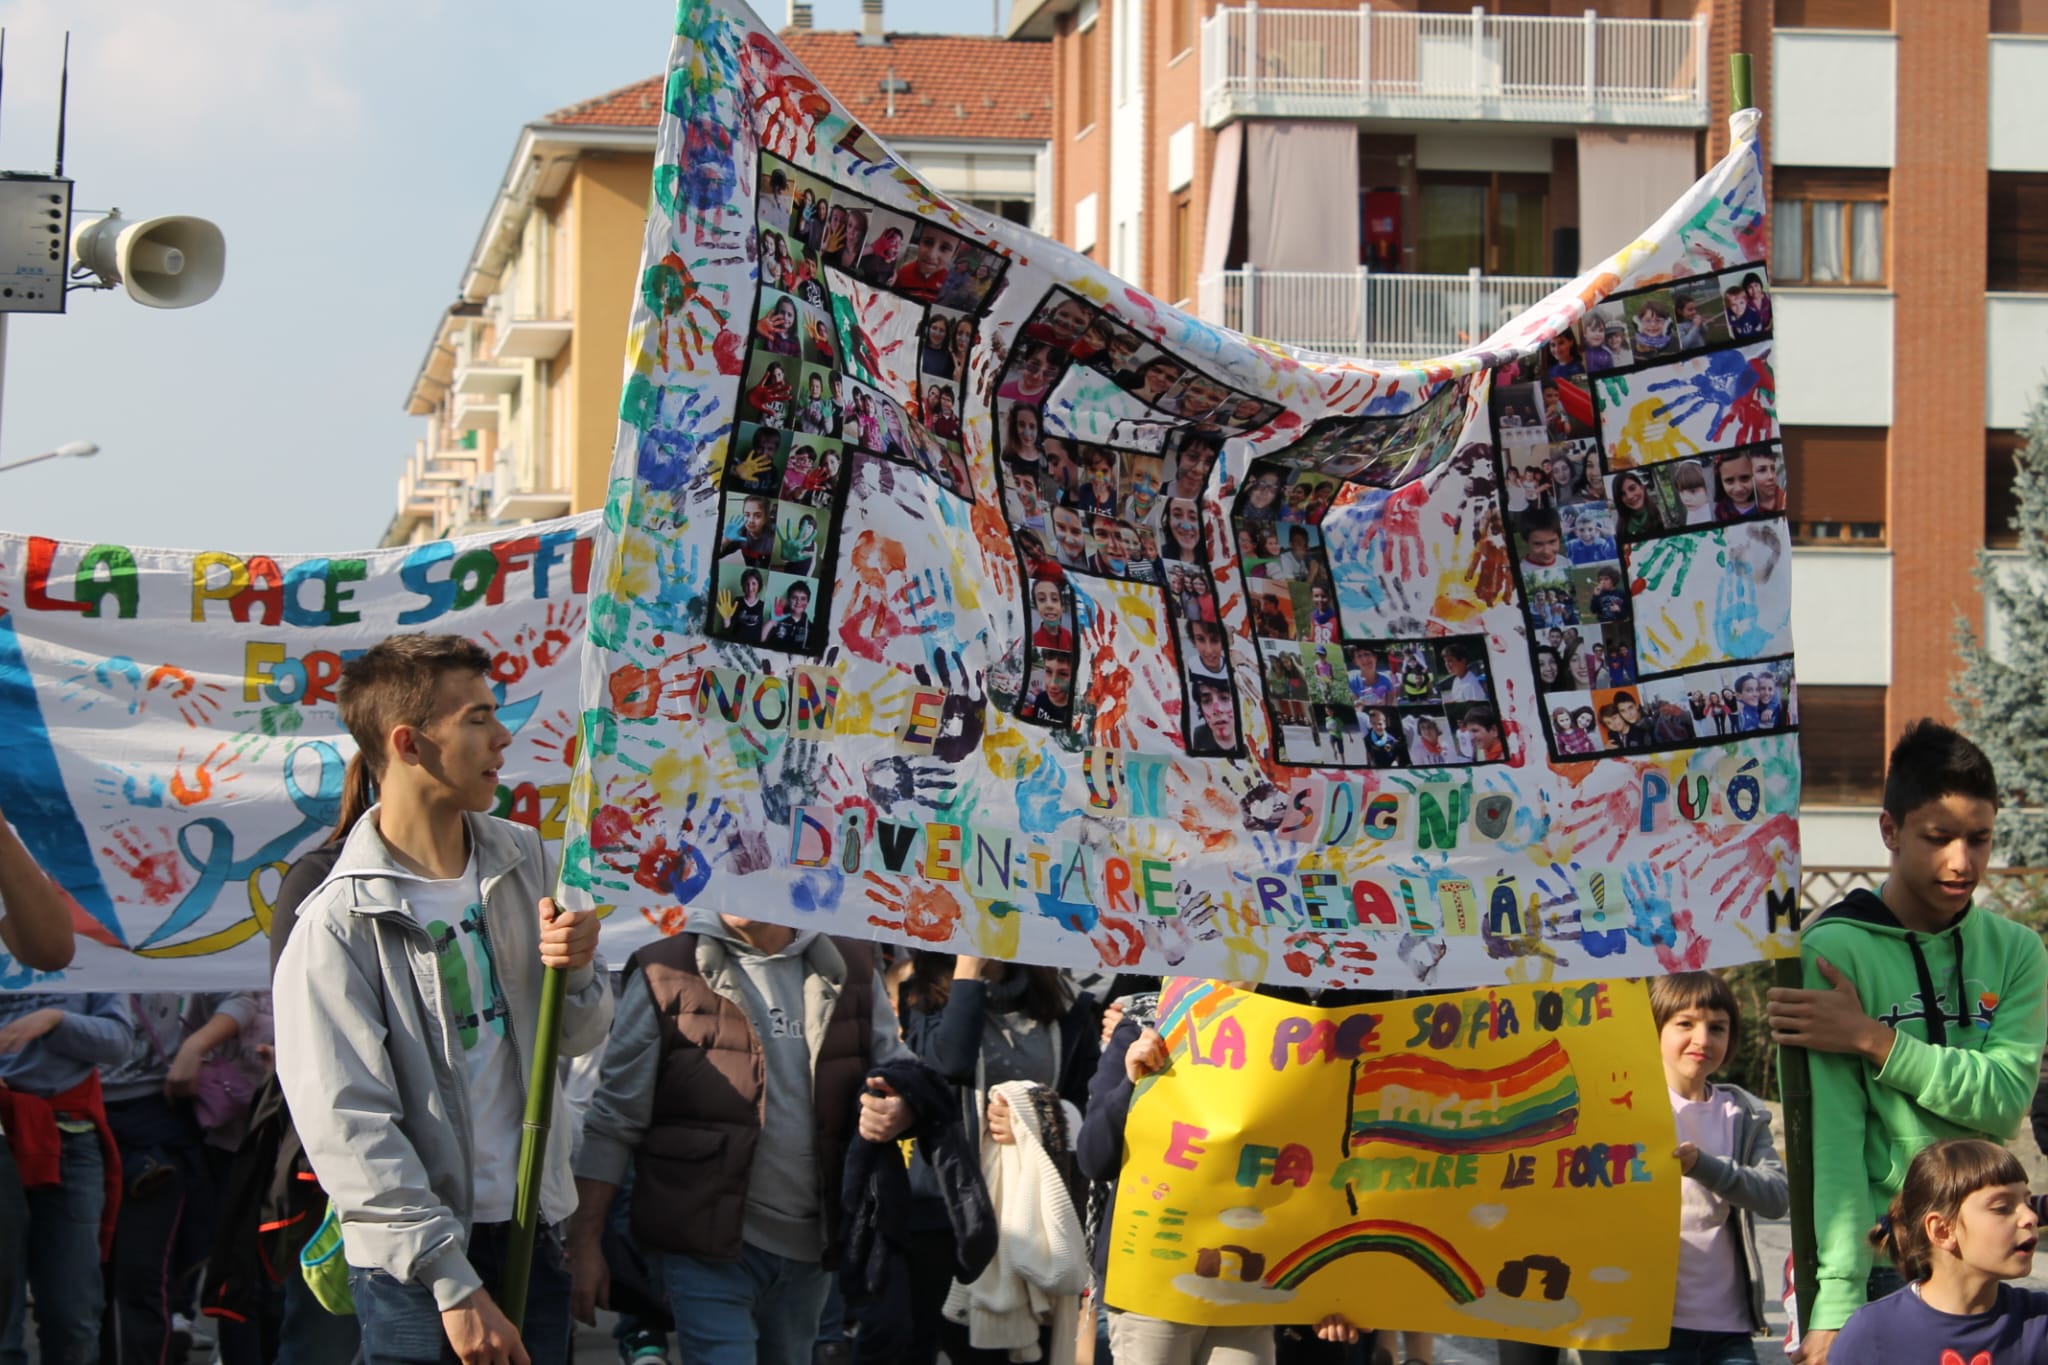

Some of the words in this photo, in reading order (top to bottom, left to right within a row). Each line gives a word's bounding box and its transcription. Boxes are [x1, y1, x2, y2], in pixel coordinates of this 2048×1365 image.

[24, 536, 140, 619] LA
[190, 550, 367, 627] PACE
[397, 528, 595, 625] SOFFI
[243, 640, 369, 706] FOR
[699, 670, 841, 731] NON
[1083, 750, 1163, 817] UN
[1185, 1009, 1247, 1070] LA
[1270, 1013, 1383, 1071] PACE
[1163, 1120, 1209, 1171] E
[1235, 1143, 1313, 1188] FA
[1501, 1152, 1536, 1190] LE
[1552, 1142, 1653, 1188] PORTE
